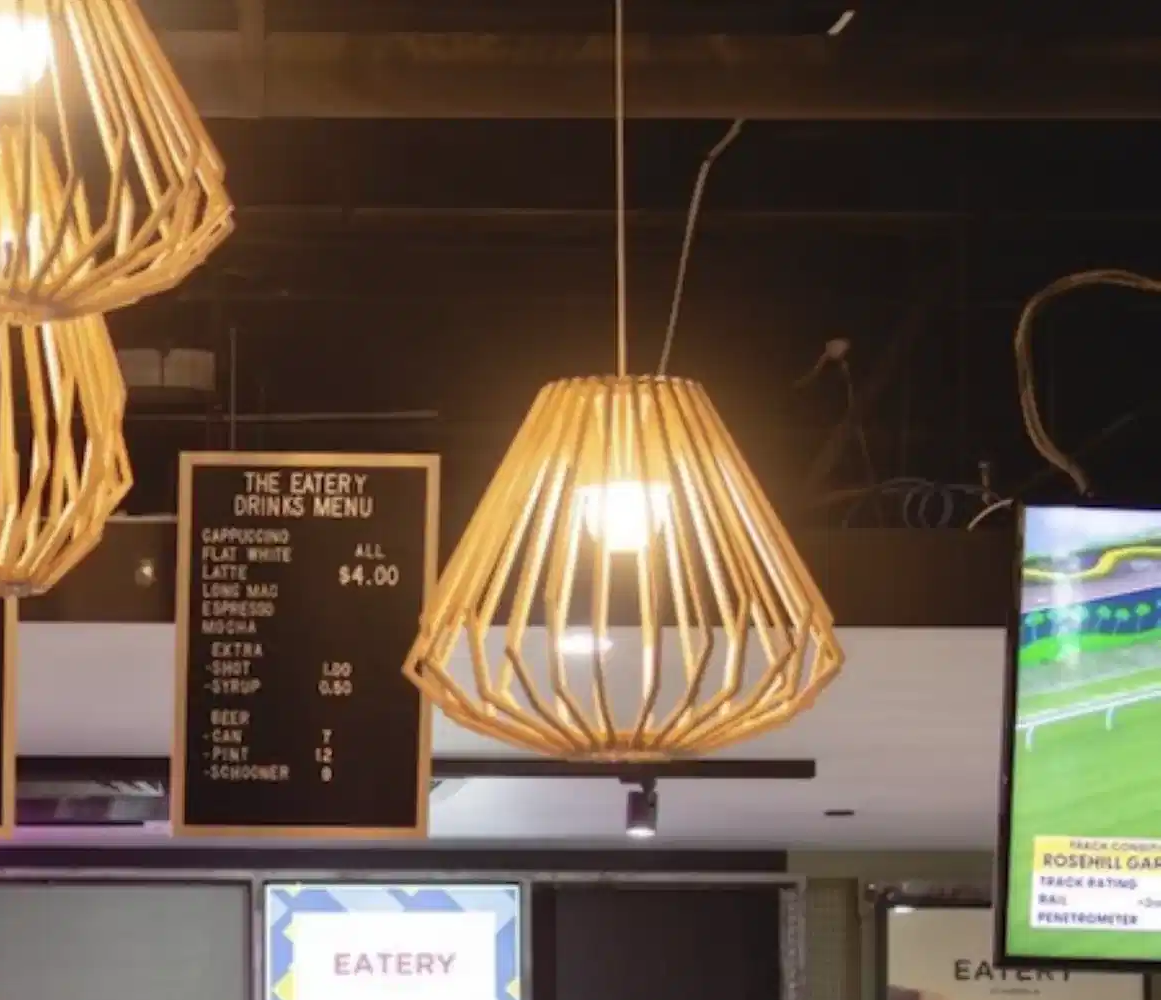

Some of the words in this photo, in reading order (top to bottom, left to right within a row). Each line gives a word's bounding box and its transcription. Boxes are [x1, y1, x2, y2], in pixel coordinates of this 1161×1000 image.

[243, 471, 281, 494] THE
[290, 472, 368, 495] EATERY
[233, 495, 305, 518] DRINKS
[313, 496, 374, 518] MENU
[201, 546, 239, 563] FLAT
[246, 546, 293, 563] WHITE
[354, 543, 387, 561] ALL
[201, 564, 248, 581] LATTE
[338, 563, 400, 588] $4.00
[202, 582, 240, 599] LONG
[201, 600, 275, 618] ESPRESSO
[201, 618, 257, 635] MOCHA
[211, 641, 263, 658] EXTRA
[211, 709, 251, 726] BEER
[1043, 853, 1122, 870] ROSEHILL
[1040, 875, 1083, 888] TRACK
[1087, 877, 1138, 890] RATING
[1037, 912, 1138, 926] PENETROMETER
[333, 951, 457, 976] EATERY
